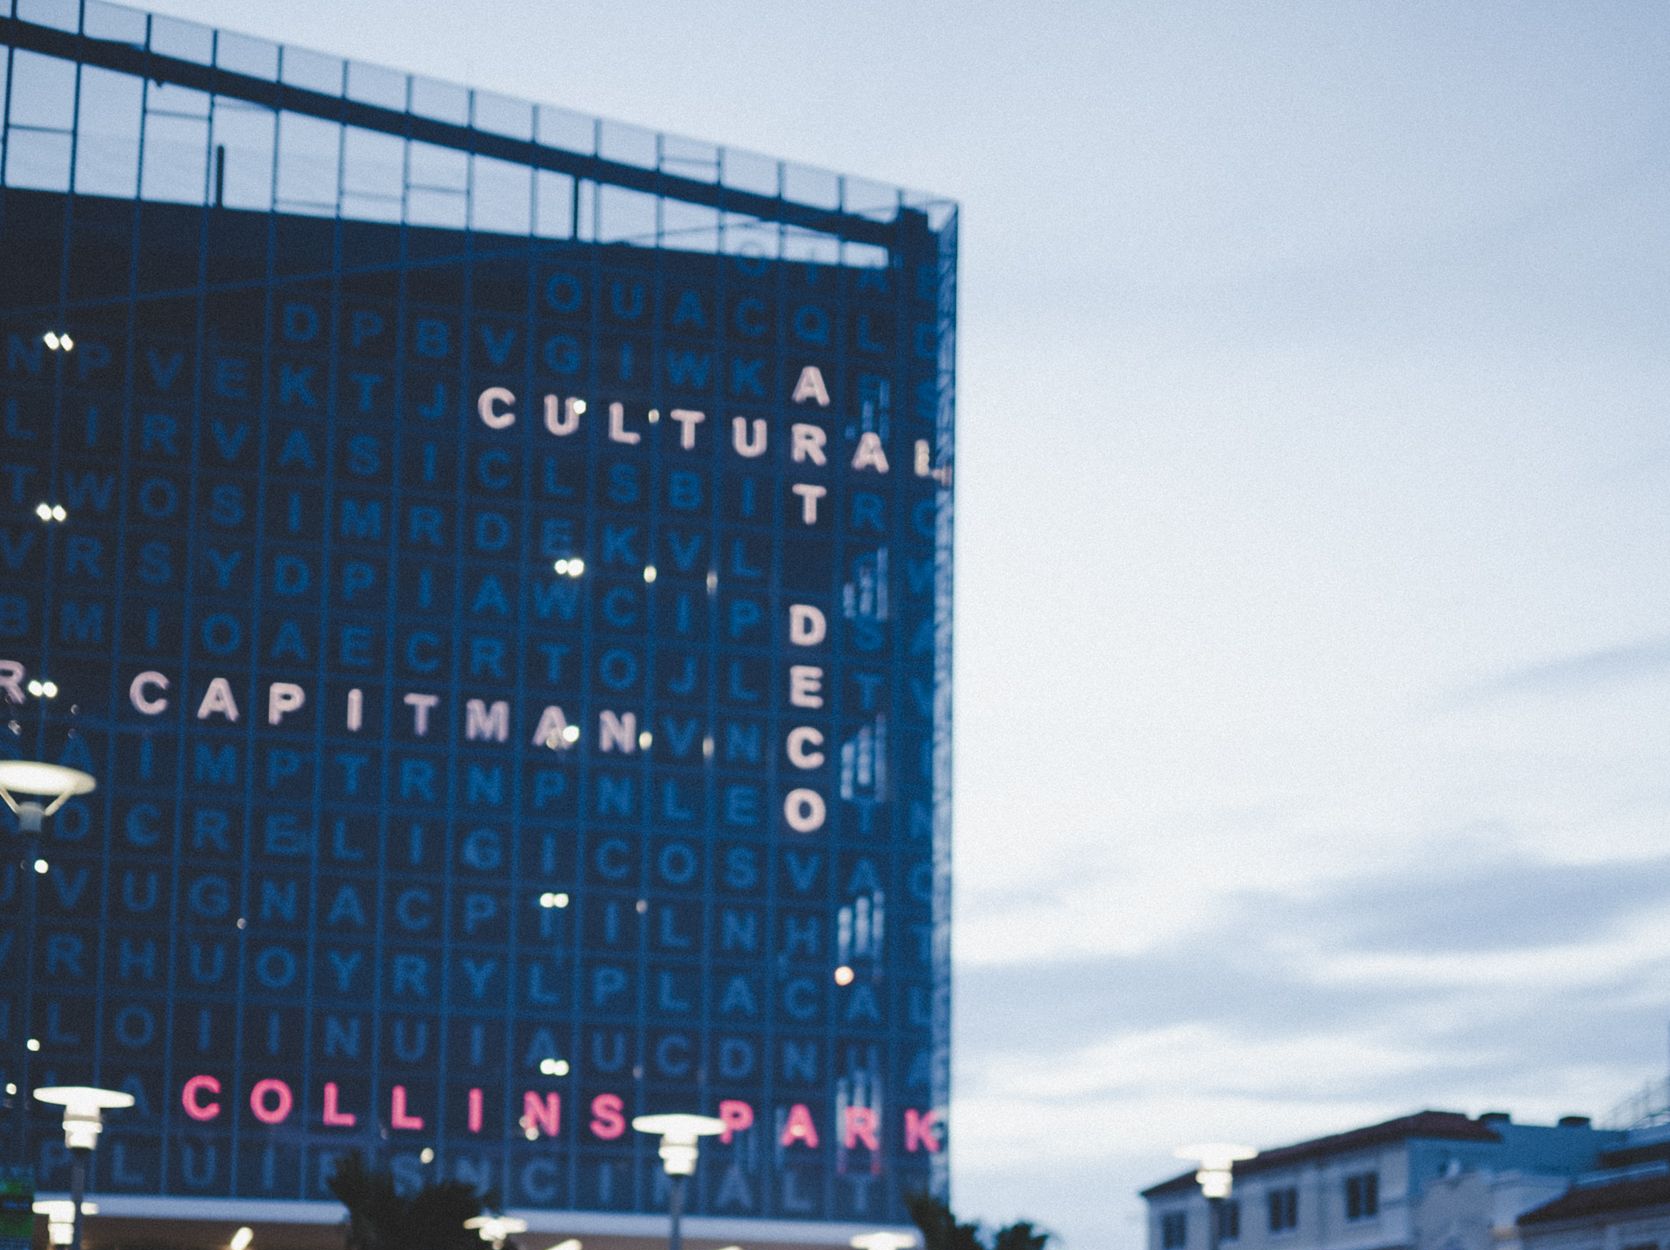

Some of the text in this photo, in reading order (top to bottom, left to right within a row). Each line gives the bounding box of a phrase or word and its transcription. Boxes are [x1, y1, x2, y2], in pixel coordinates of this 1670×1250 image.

[477, 384, 946, 478] CULTURAL
[785, 361, 828, 832] ART DECO
[129, 669, 636, 754] CAPITMAN
[181, 1074, 627, 1139] COLLINS
[717, 1099, 940, 1153] PARK
